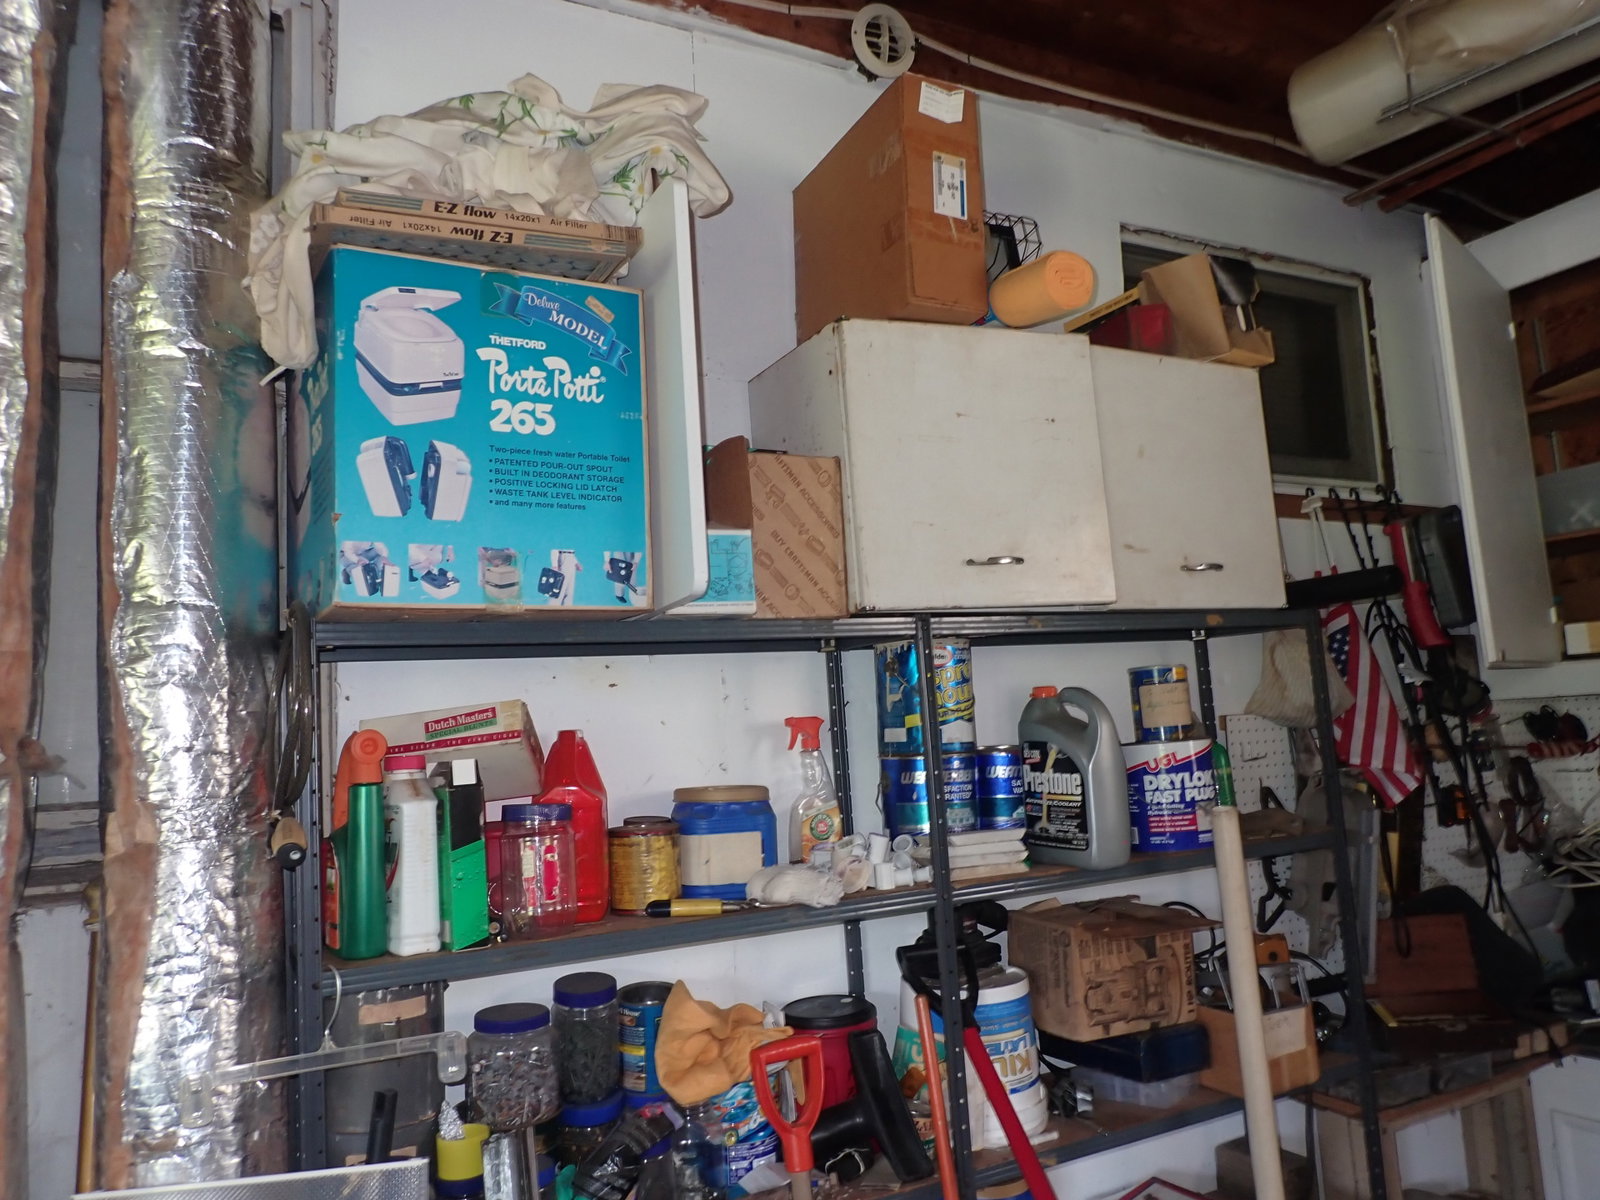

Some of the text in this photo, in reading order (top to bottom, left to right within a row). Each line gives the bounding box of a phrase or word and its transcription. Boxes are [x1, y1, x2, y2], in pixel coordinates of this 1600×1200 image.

[434, 201, 589, 231] E-Z flow 14x20x1 Air Filter
[348, 215, 514, 245] E-Z flow 14x20x1 Air Filter
[522, 292, 561, 312] Deluxe
[549, 309, 608, 351] MODEL
[489, 335, 547, 350] THETFORD
[475, 347, 605, 404] Porta Potti
[489, 398, 556, 435] 265
[489, 445, 630, 463] Two-piece fresh water Portable Toilet
[494, 458, 613, 473] PATENTED POUR-OUT SPOUT
[774, 456, 800, 488] AFTSMAN
[494, 468, 625, 484] BUILT IN DEODORANT STORAGE
[494, 478, 617, 493] POSITIVE LOCKING LID LATCH
[494, 488, 623, 503] WASTE TANK LEVEL INDICATOR
[511, 501, 533, 509] many
[556, 502, 586, 511] features
[428, 718, 456, 732] Dutch
[429, 726, 461, 739] SPECIAL
[1145, 752, 1179, 773] UGL
[1022, 764, 1082, 795] Prestone
[1143, 769, 1214, 791] DRYLOK
[1145, 789, 1182, 804] FAST
[1184, 786, 1216, 802] PLUG
[992, 1049, 1032, 1078] KIL
